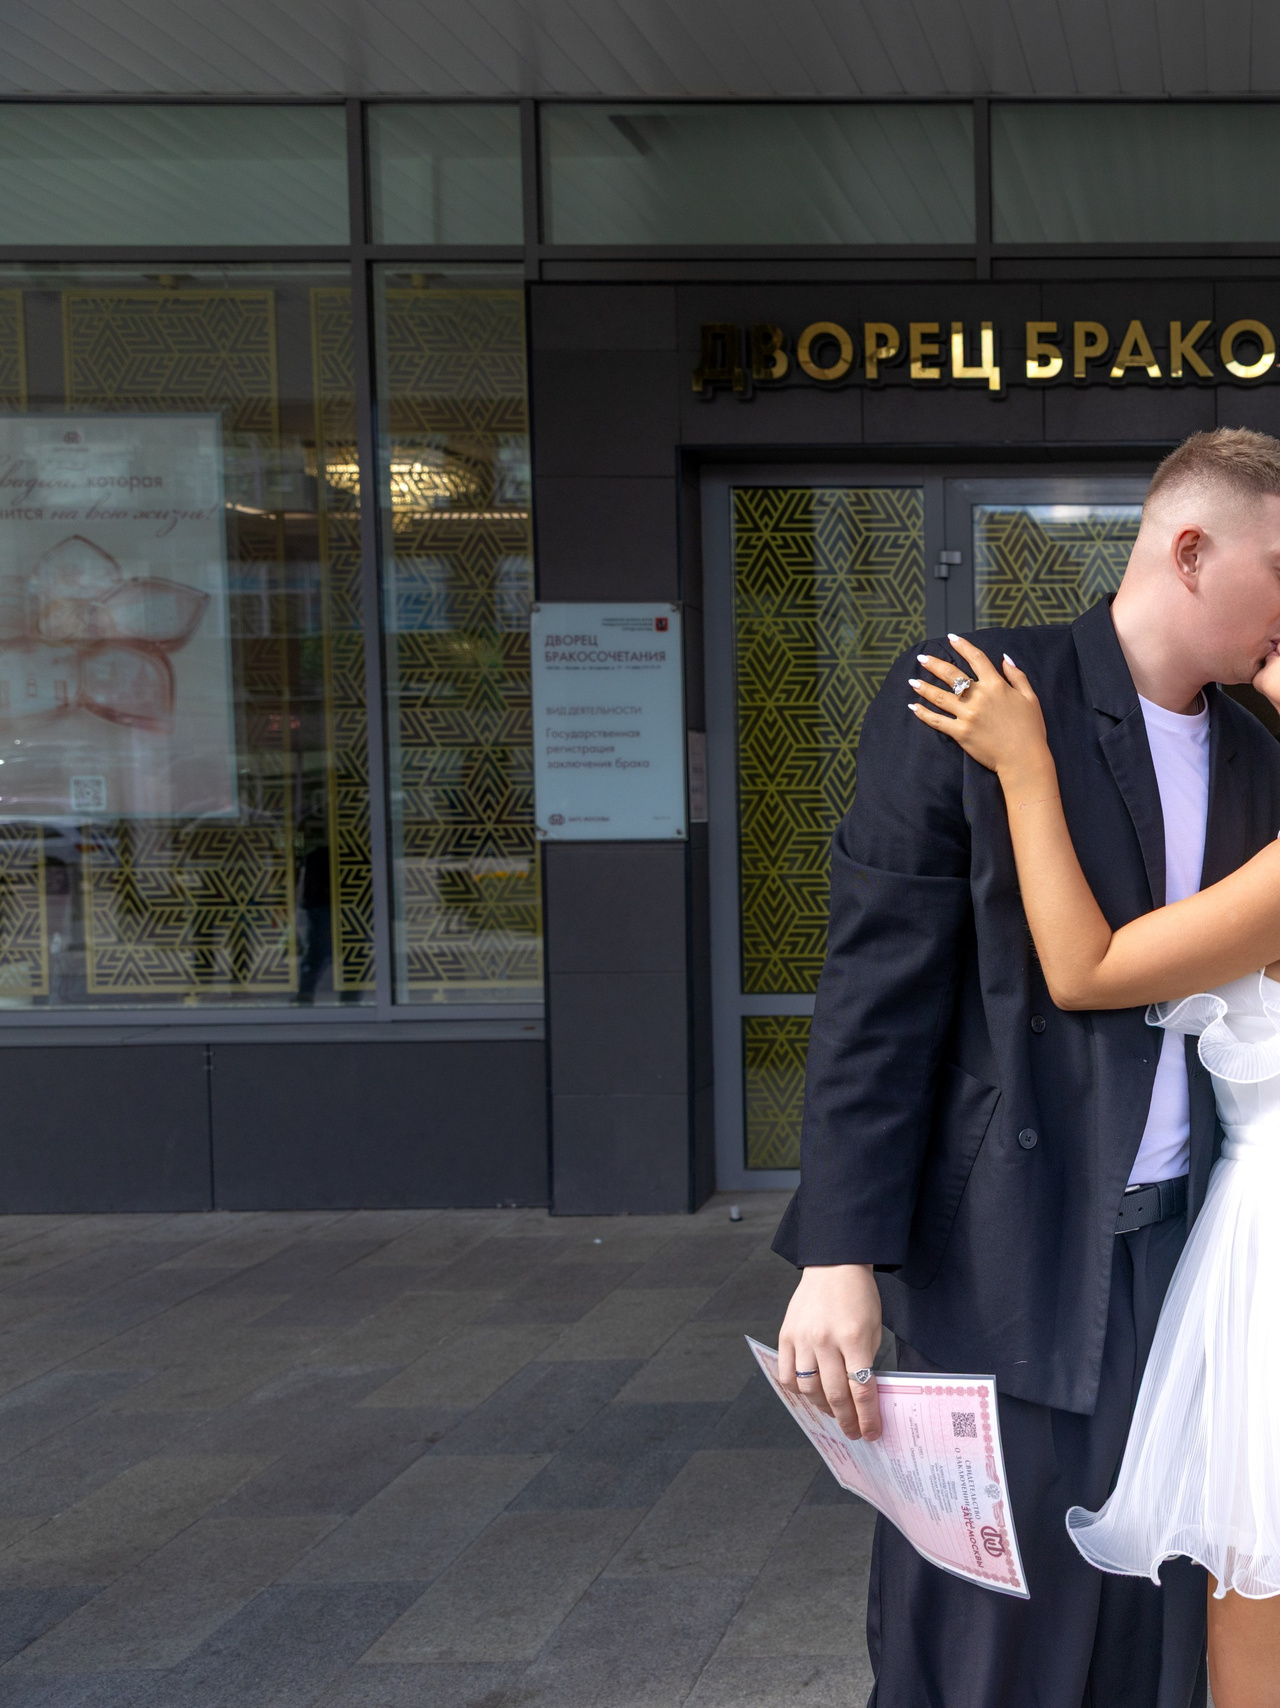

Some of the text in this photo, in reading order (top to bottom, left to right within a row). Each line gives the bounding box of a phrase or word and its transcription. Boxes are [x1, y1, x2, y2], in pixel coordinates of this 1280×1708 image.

[692, 320, 1000, 391] ДВОРЕЦ
[87, 475, 163, 493] которая
[545, 634, 598, 647] ДВОРЕЦ
[545, 650, 666, 662] БРАКОСОЧЕТАНИЯ
[568, 706, 642, 716] ДЕЯТЕЛЬНОСТИ
[546, 727, 641, 741] Государственная
[546, 744, 615, 755] регистрация
[615, 757, 650, 771] брака
[965, 1460, 981, 1520] СВИДЕТЕЛЬСТВО
[961, 1505, 984, 1569] ЗАГС МОСКВЫ
